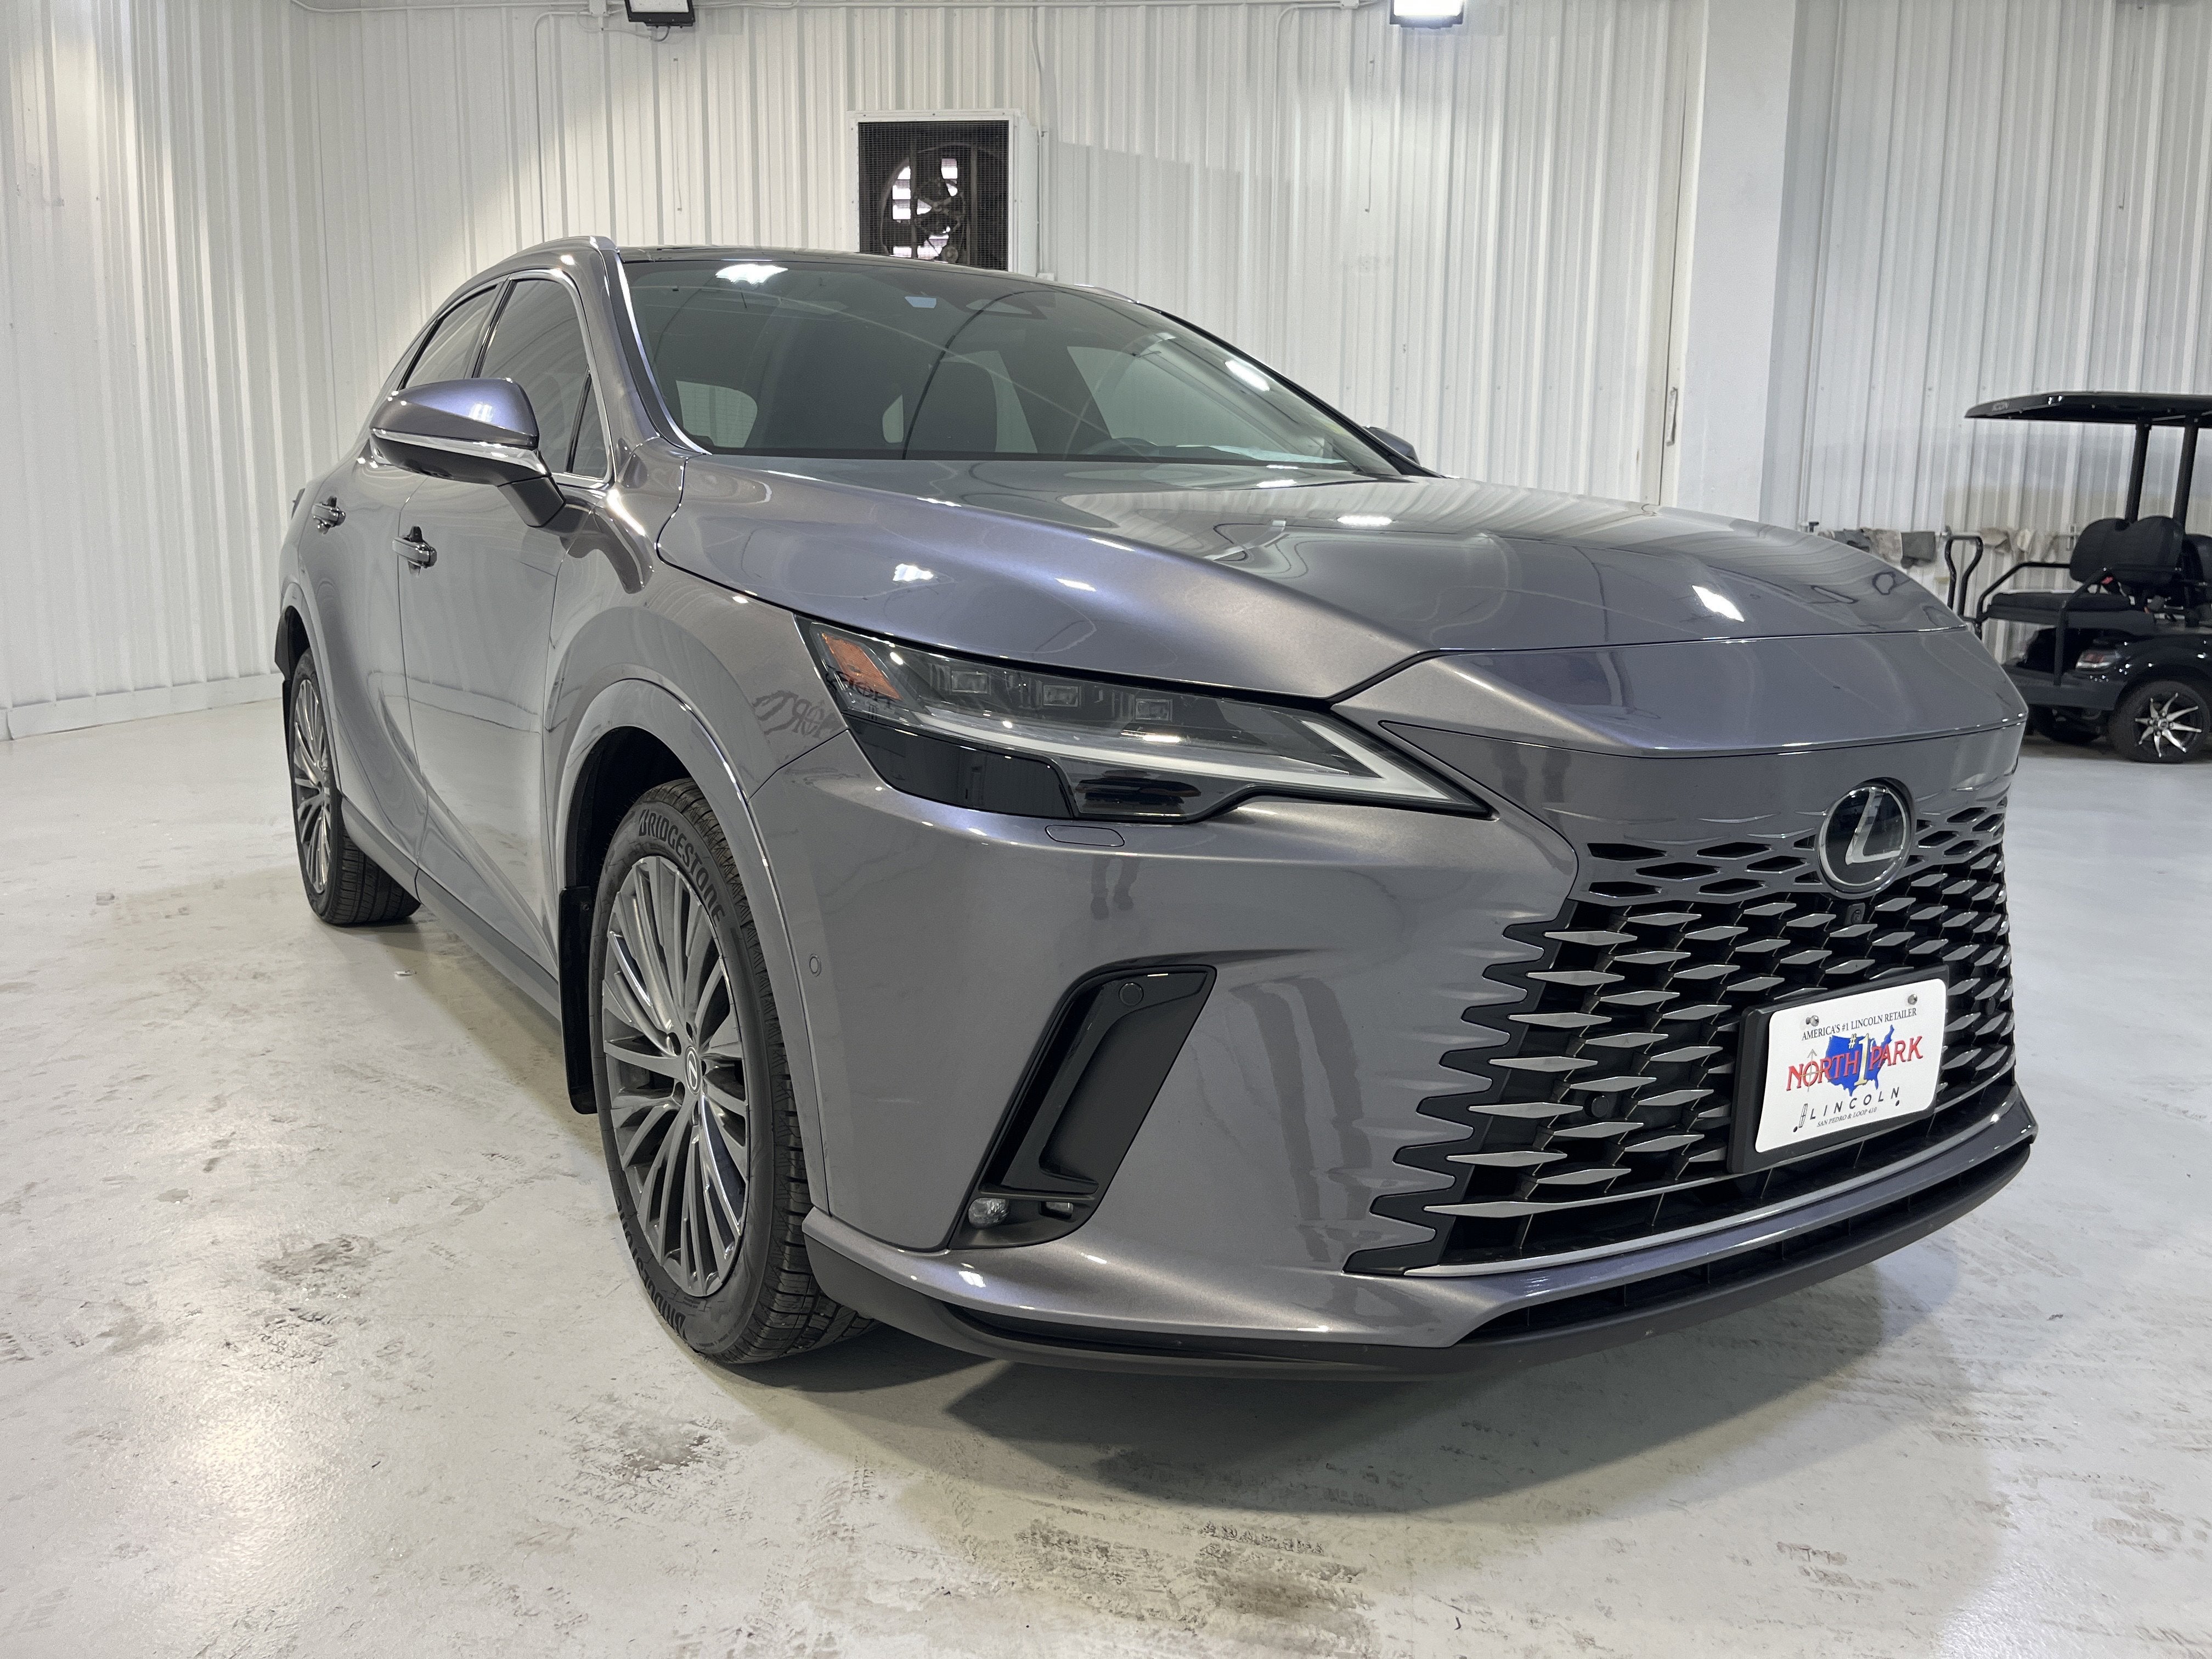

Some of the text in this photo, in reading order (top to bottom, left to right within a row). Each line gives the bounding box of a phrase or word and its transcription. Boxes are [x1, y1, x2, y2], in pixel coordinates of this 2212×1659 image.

[638, 809, 726, 924] BRIDGESTONE
[1802, 1007, 1917, 1041] AMERICA'S #1 LINCOLN RETAILER
[1786, 1036, 1923, 1091] NORTH PARK
[1810, 1087, 1899, 1120] LINCOLN
[1829, 1114, 1847, 1125] PEDRO
[1853, 1109, 1867, 1118] LOOP
